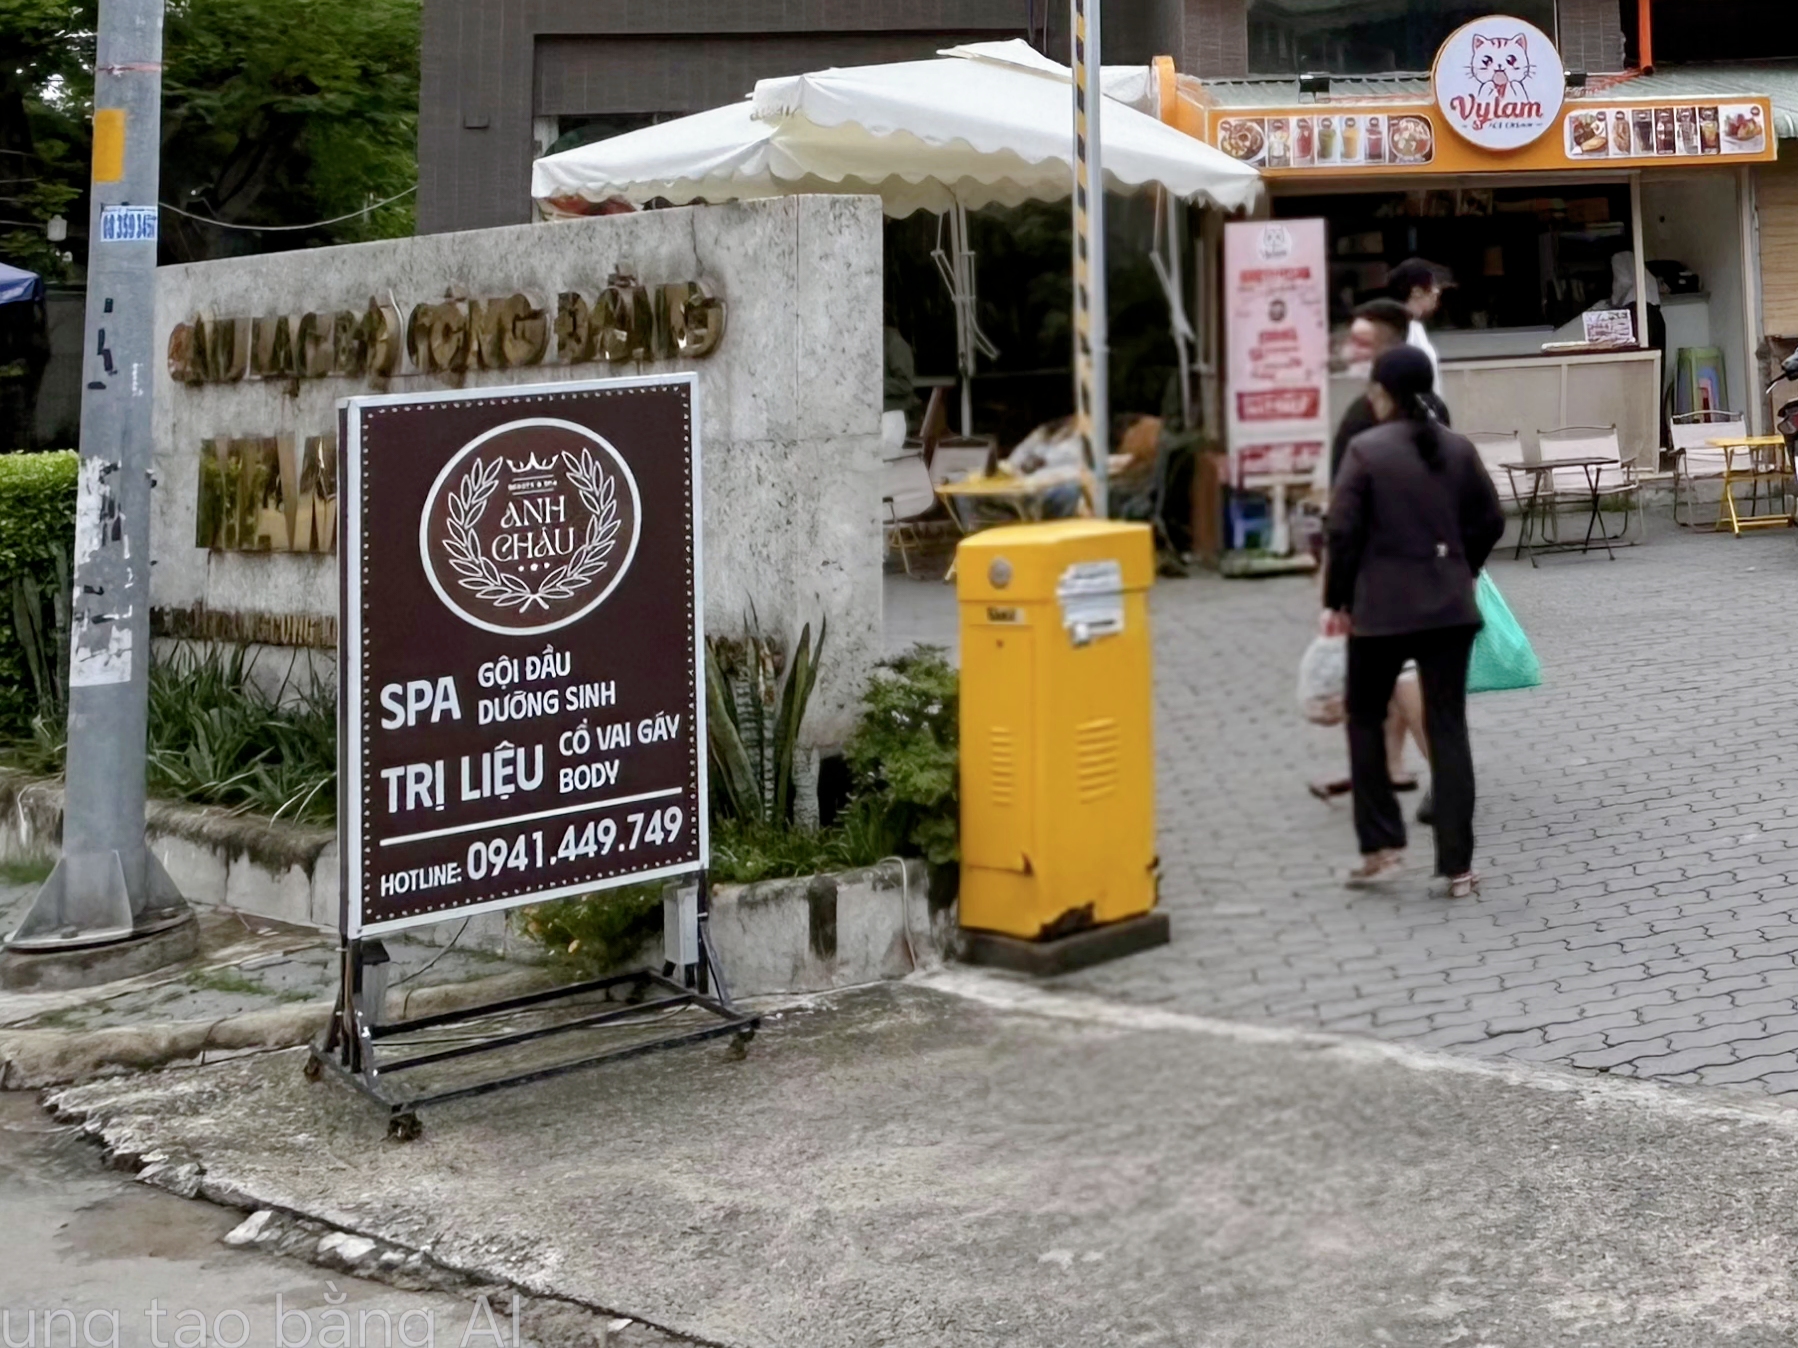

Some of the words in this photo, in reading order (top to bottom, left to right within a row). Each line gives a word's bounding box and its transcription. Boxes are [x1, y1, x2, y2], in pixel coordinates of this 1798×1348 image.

[1449, 93, 1544, 131] Vylam
[500, 495, 565, 529] ANH
[477, 655, 519, 690] GỘI
[525, 644, 571, 681] ĐẦU
[379, 675, 462, 730] SPA
[478, 689, 559, 726] DƯỠNG
[565, 680, 617, 712] SINH
[559, 718, 591, 757] CỔ
[596, 721, 631, 751] VAI
[636, 710, 680, 745] GÁY
[380, 759, 445, 814] TRỊ
[460, 740, 544, 802] LIỆU
[558, 759, 620, 794] BODY
[380, 861, 463, 897] HOTLINE:
[466, 805, 684, 882] 0941.449.749
